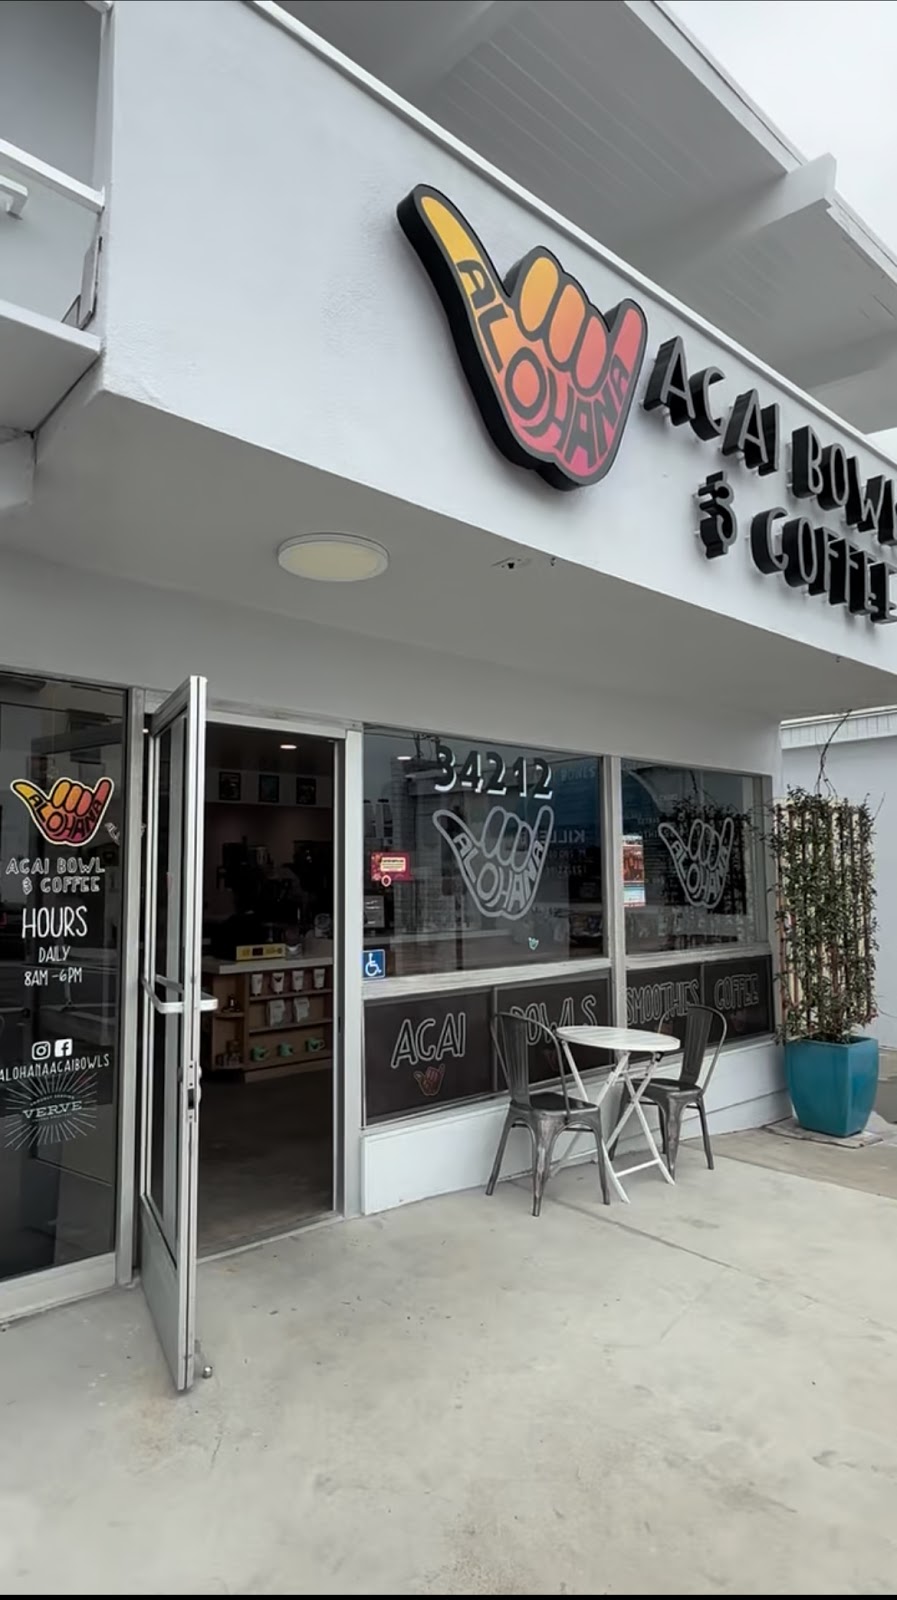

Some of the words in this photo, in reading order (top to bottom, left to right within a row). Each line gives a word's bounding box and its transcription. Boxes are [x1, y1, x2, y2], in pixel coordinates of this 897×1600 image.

[456, 259, 631, 468] ALOHANA
[643, 335, 780, 476] ACAI
[790, 425, 897, 547] BOWL
[751, 507, 897, 625] COFFEE
[434, 746, 552, 799] 34212
[28, 793, 103, 840] ALOHANA
[5, 857, 50, 875] ACAI
[56, 856, 106, 875] BOWL
[40, 875, 101, 894] COFFEE
[453, 833, 545, 912] ALOHANA
[671, 840, 729, 901] ALOHANA
[21, 905, 89, 939] HOURS
[38, 946, 71, 964] DAILY
[714, 973, 760, 1011] COFFEE
[391, 1012, 467, 1069] ACAI
[22, 1100, 83, 1119] VERVE
